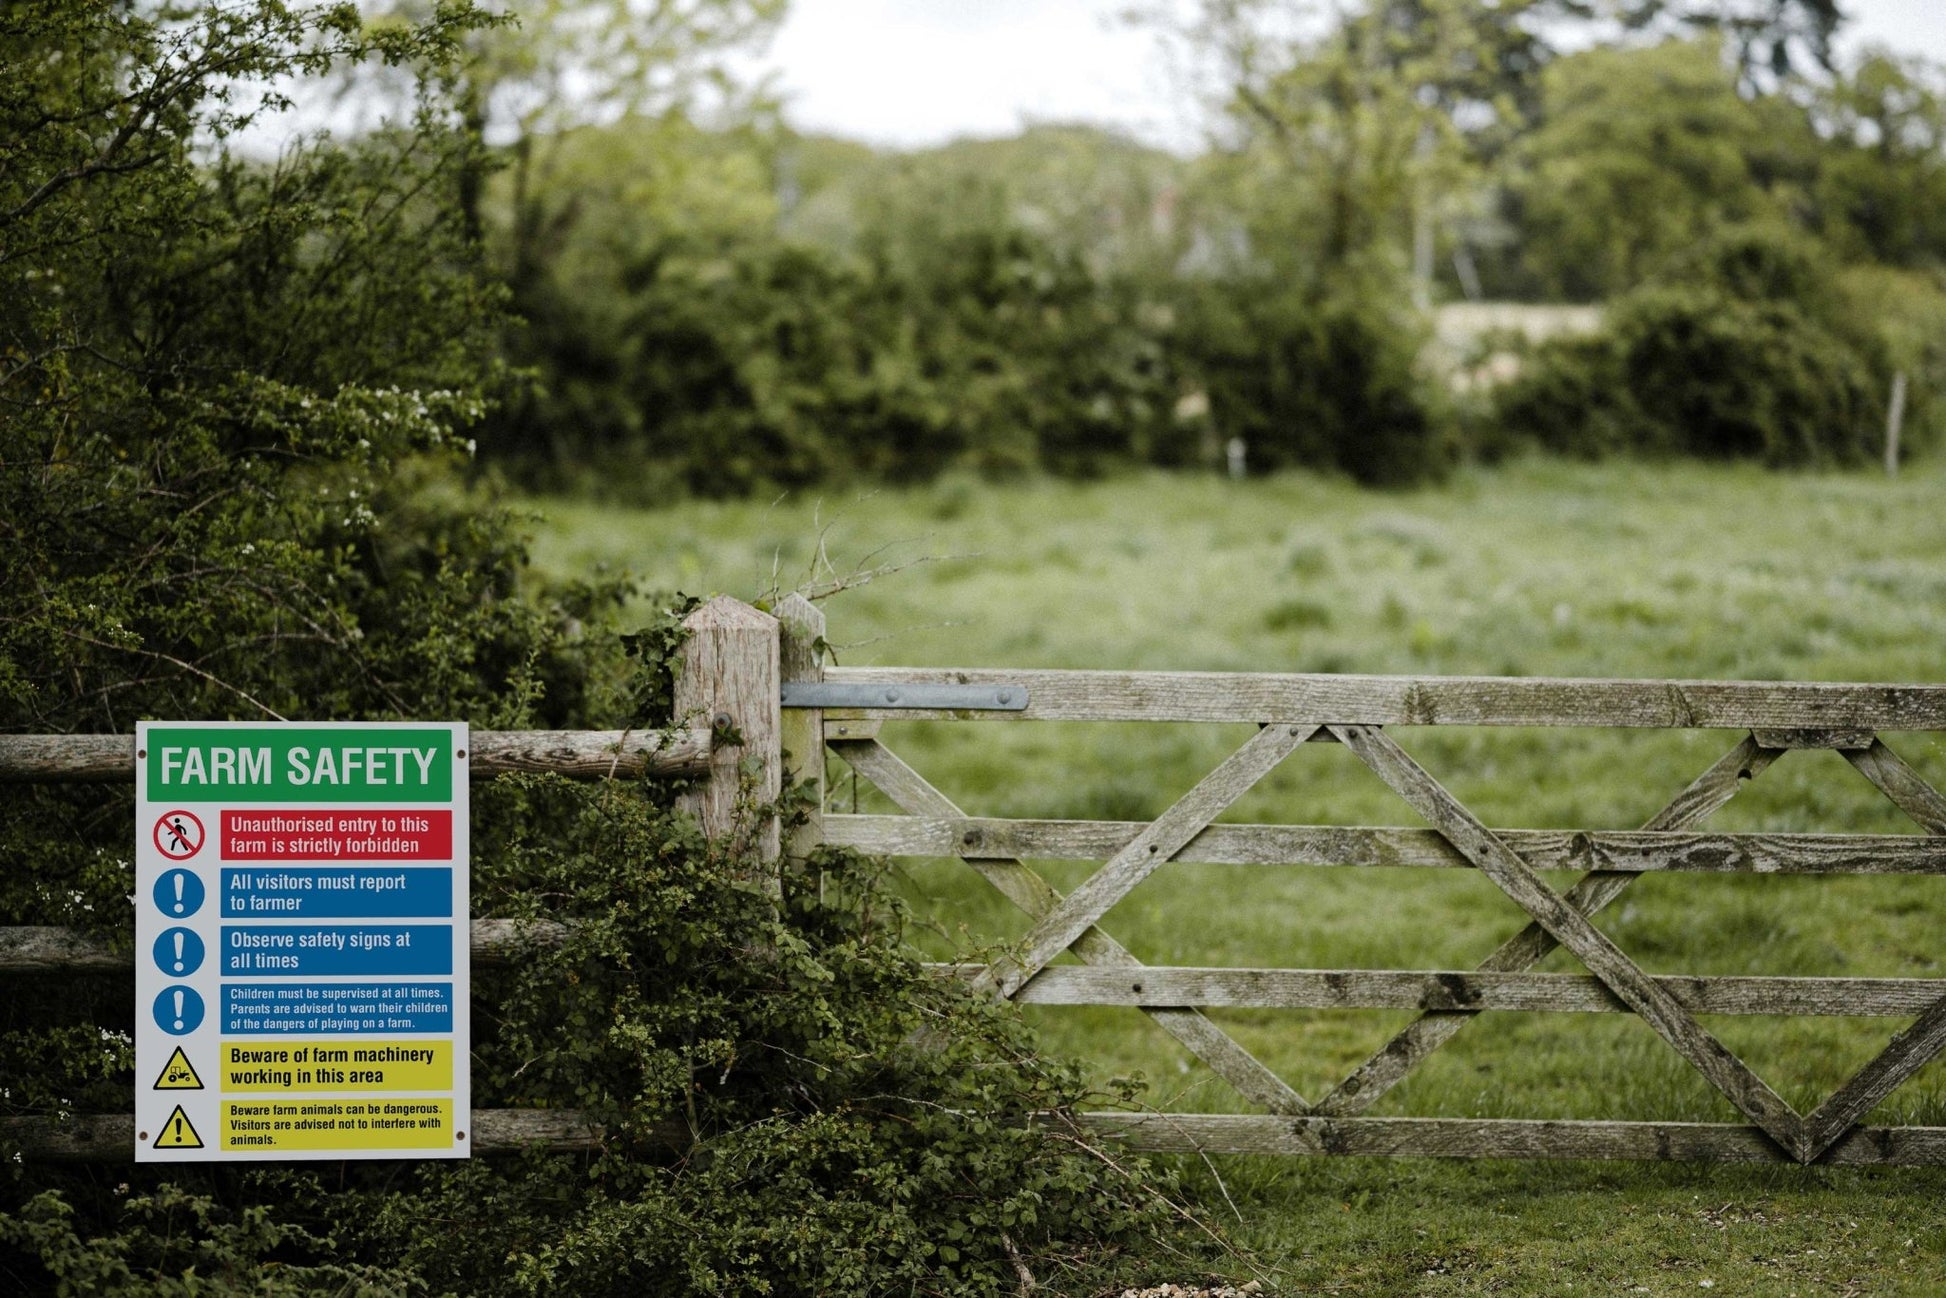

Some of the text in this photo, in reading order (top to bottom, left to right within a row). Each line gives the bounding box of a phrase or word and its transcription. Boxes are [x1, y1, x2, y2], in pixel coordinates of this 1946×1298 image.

[162, 747, 437, 785] FARM SAFETY
[232, 817, 428, 835] Unauthorised entry to this
[231, 837, 418, 855] farm is strictly forbidden
[231, 874, 405, 892] All visitors must report
[231, 895, 302, 910] to farmer
[232, 932, 410, 950] Observe safety signs at
[231, 953, 298, 968] all times
[231, 988, 443, 1000] Children must be supervised at all times.
[231, 1004, 270, 1014] Parents
[294, 1003, 333, 1013] advised
[337, 1004, 346, 1013] to
[350, 1005, 375, 1013] warn
[379, 1003, 402, 1013] their
[406, 1003, 447, 1013] children
[231, 1018, 415, 1031] of the dangers of playing on a farm.
[232, 1047, 433, 1064] Beware of farm machinery
[231, 1068, 383, 1087] working in this area
[231, 1104, 442, 1116] Beware farm animals can be dangerous.
[231, 1118, 440, 1130] Visitors are advised not to interfere with
[231, 1134, 277, 1145] animals.
